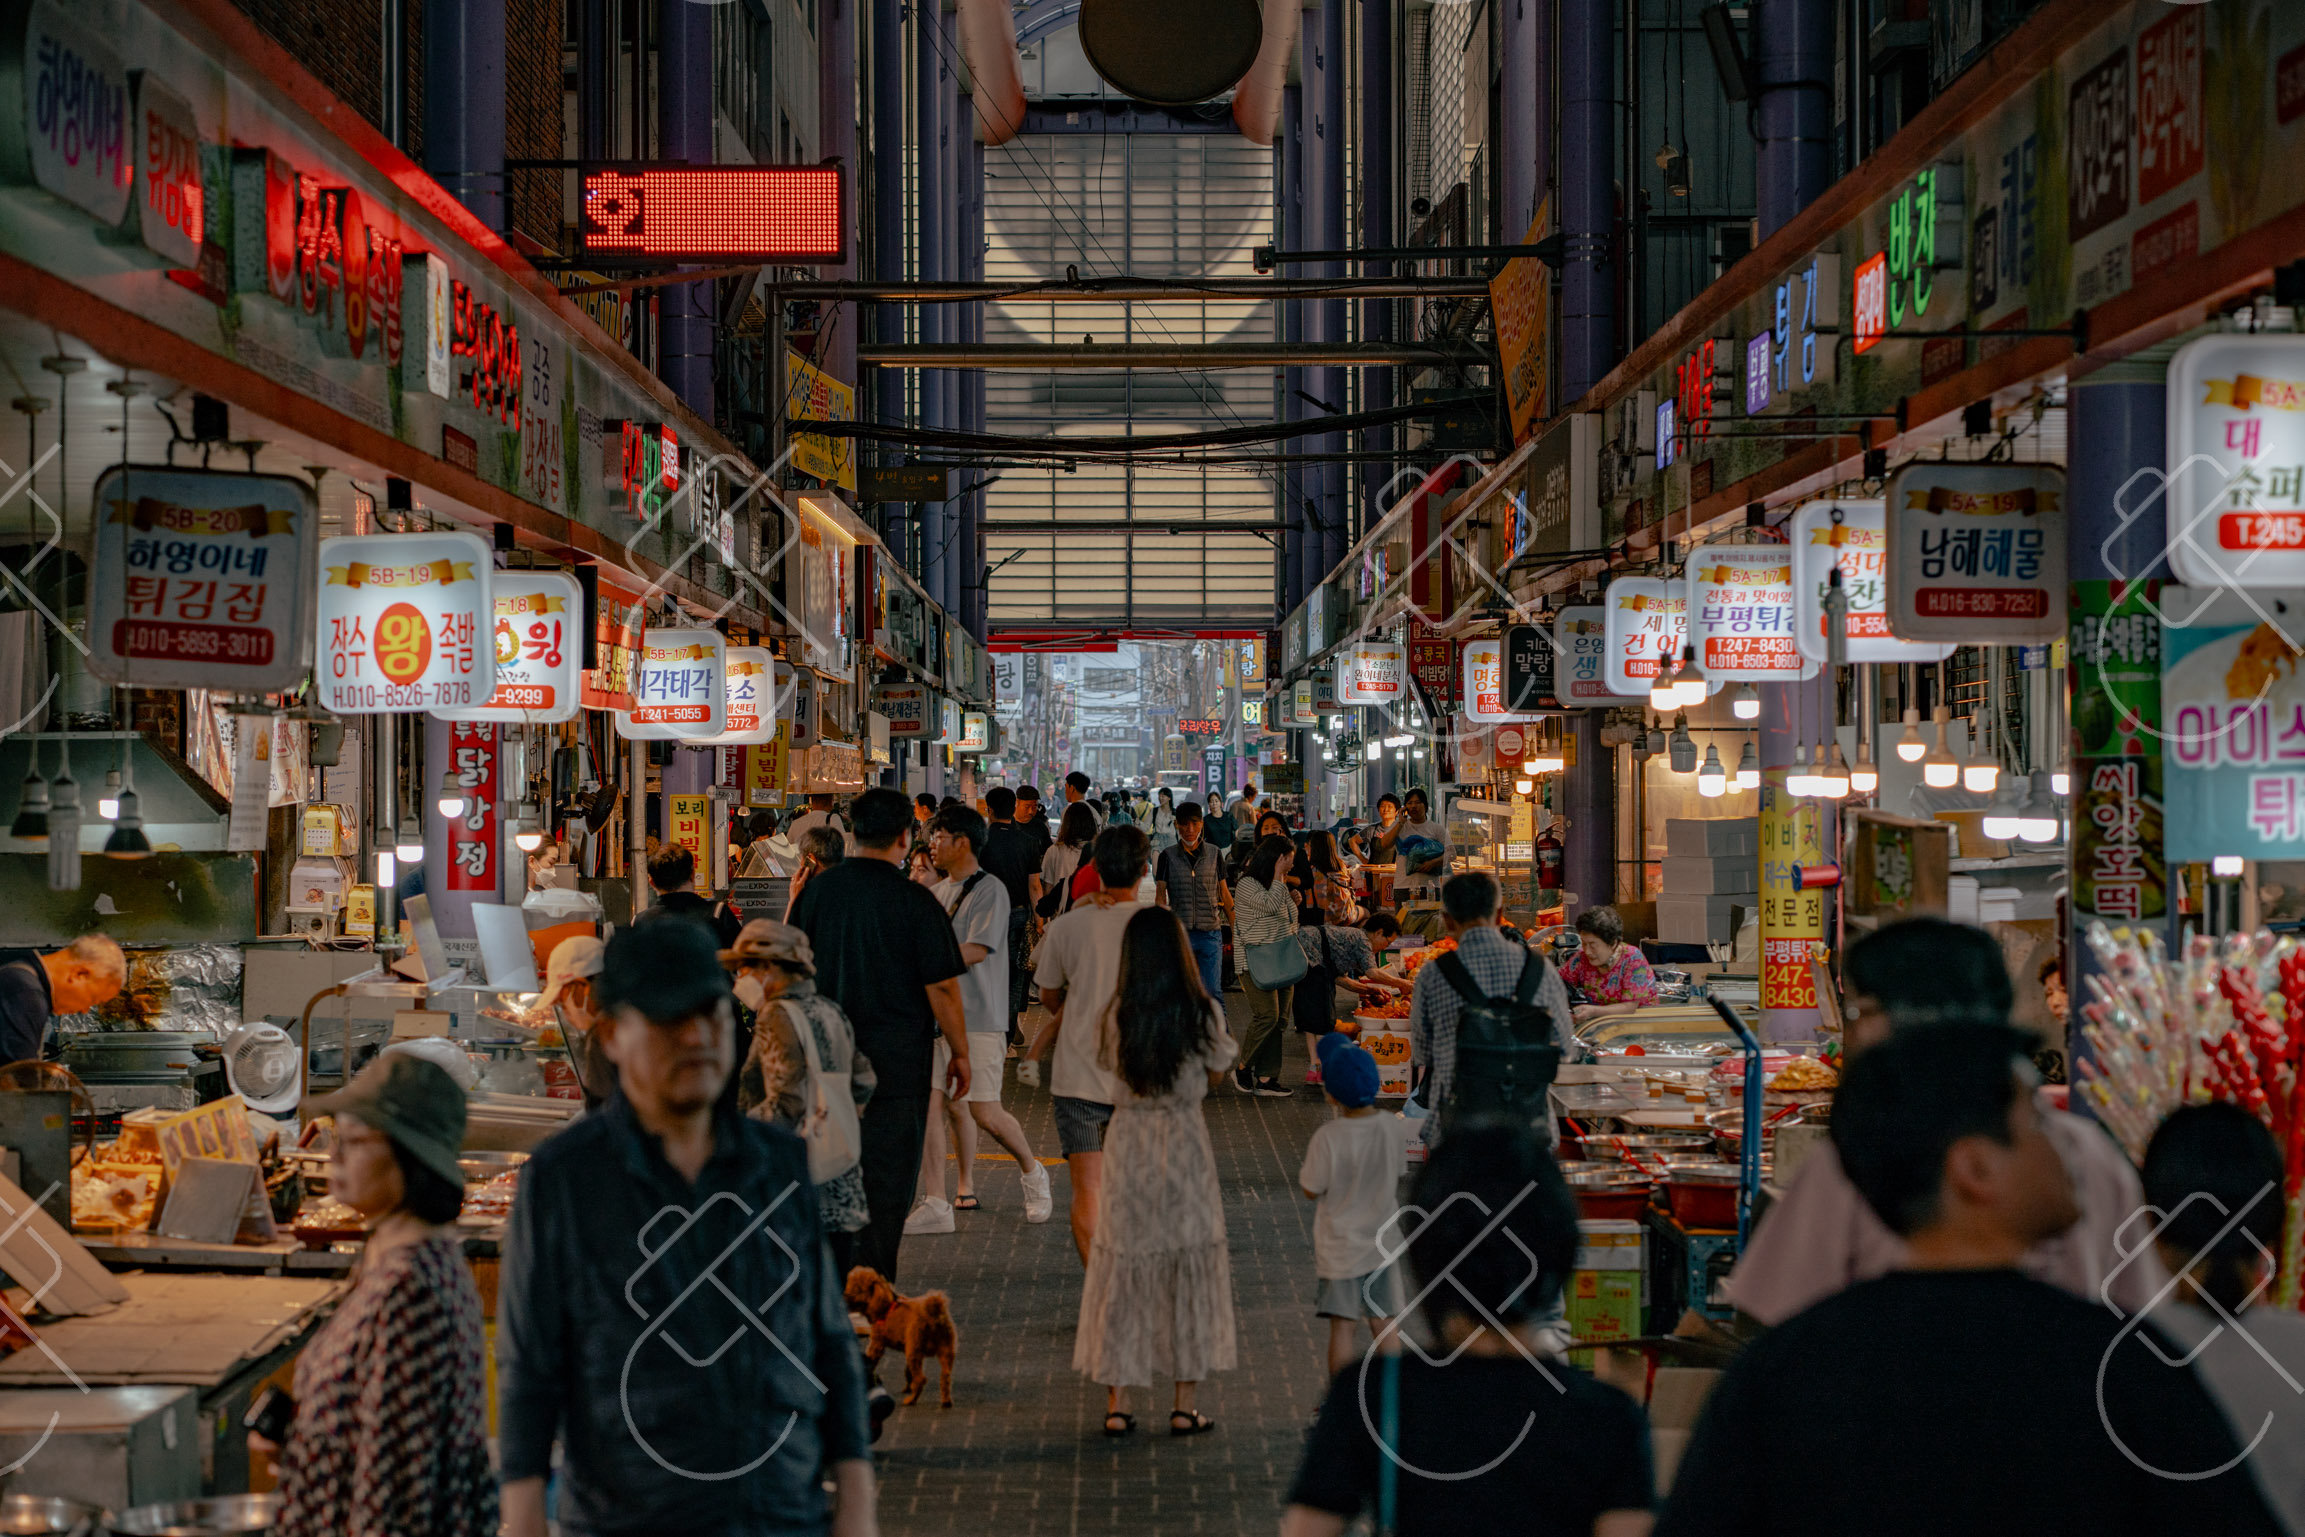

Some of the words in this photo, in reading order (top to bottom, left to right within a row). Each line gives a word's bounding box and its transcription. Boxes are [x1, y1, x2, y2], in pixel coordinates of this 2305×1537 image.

[37, 35, 123, 190] 하영이네
[1889, 167, 1937, 329] 반찬
[1774, 258, 1818, 393] 튀김
[2224, 417, 2262, 459] 대
[1950, 493, 2017, 512] 5A-19
[164, 507, 241, 531] 5B-20
[127, 538, 269, 578] 하영이네
[1920, 527, 2046, 580] 남해해물
[369, 566, 431, 585] 5B-19
[1731, 569, 1779, 583] 5A-17
[126, 576, 267, 624] 튀김집
[1647, 599, 1687, 611] 5A-16
[1705, 588, 1747, 604] 전통과
[128, 626, 268, 658] .010-5893-3011
[329, 614, 367, 679] 장수
[378, 613, 427, 677] 왕
[438, 611, 475, 674] 족발
[521, 619, 562, 668] 윙
[650, 648, 688, 660] 5B-17
[1715, 637, 1794, 653] T.247-8430
[1026, 654, 1037, 684] OTEL
[1240, 638, 1258, 677] 계탕
[1372, 661, 1394, 670] 소문난
[1515, 652, 1554, 674] 말랑
[1572, 655, 1597, 680] 생
[1708, 653, 1801, 669] H.010-6503-0600
[1354, 669, 1401, 682] 완이네분식
[333, 682, 472, 708] H.010-8526-7878
[639, 707, 702, 721] T.241-5055
[757, 742, 779, 789] 비빔밥
[456, 748, 492, 876] 닭강정
[674, 800, 705, 817] 보리
[2251, 774, 2305, 840] 튀
[2092, 762, 2145, 919] 씨앗호떡
[1764, 897, 1820, 927] 전문점
[1765, 964, 1815, 986] 247-
[1765, 986, 1819, 1007] 8430
